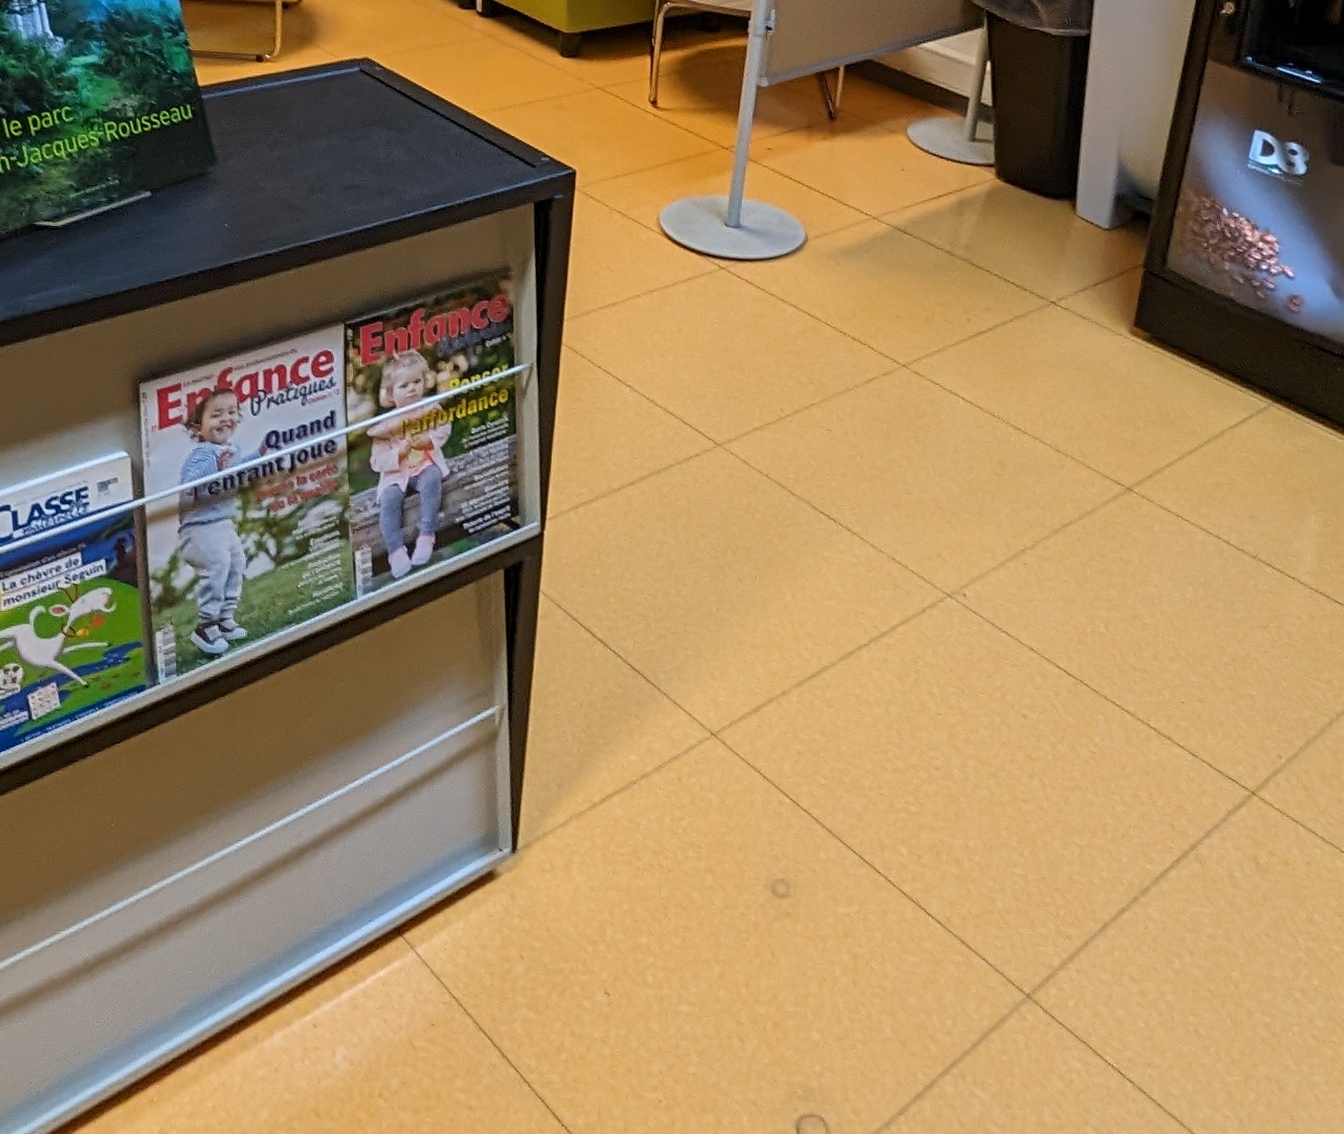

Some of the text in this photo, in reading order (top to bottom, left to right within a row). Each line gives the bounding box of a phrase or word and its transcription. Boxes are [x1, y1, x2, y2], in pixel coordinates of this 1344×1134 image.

[3, 115, 23, 139] le
[29, 106, 74, 141] parc
[360, 294, 510, 365] Enfance
[250, 377, 337, 416] Pratiques
[401, 389, 509, 436] l'affordance
[265, 411, 336, 450] Quand
[2, 579, 17, 592] La
[21, 563, 63, 586] chèvre
[3, 564, 105, 607] monsieur Seguin
